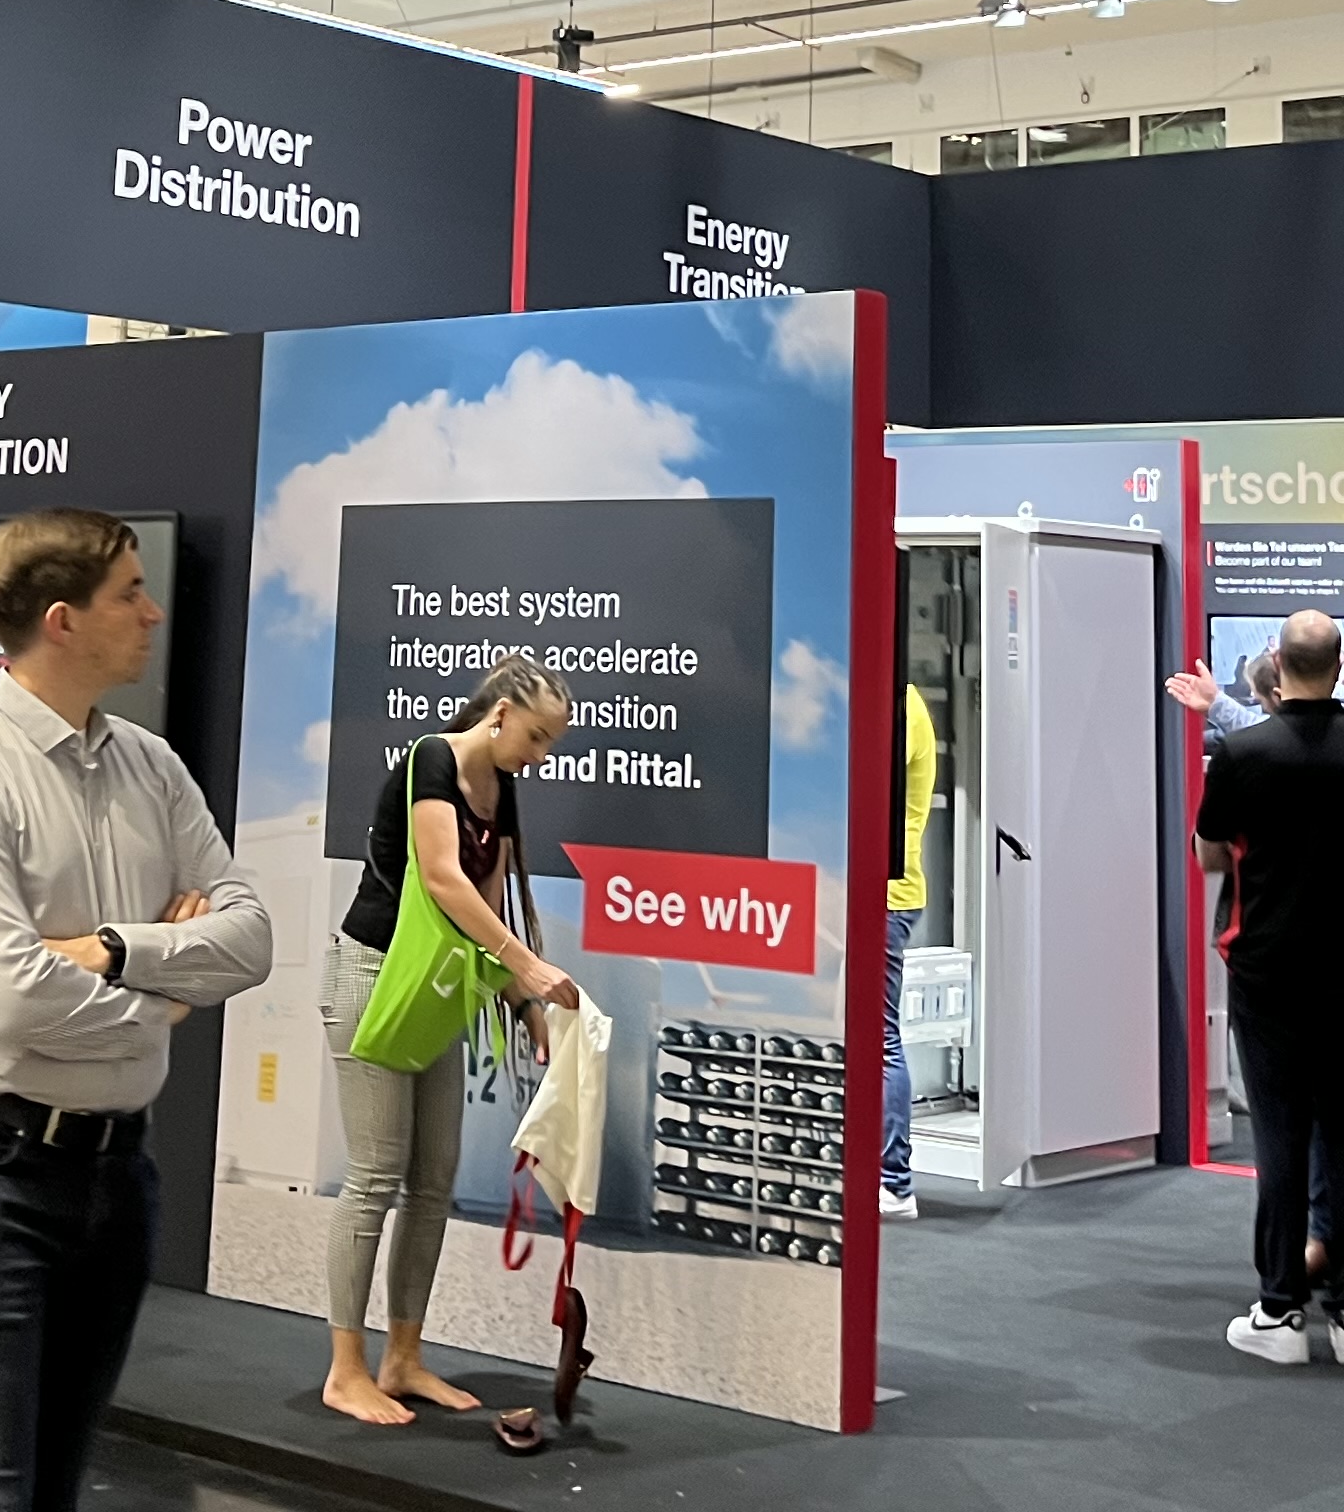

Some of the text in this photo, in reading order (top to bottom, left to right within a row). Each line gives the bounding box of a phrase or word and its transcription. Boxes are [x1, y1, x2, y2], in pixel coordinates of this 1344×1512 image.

[178, 97, 313, 167] Power
[114, 148, 361, 238] Distribution
[686, 204, 790, 270] Energy
[392, 584, 621, 627] The best system
[544, 639, 699, 676] accelerate
[387, 688, 430, 721] the
[567, 694, 678, 731] ansition
[539, 749, 598, 783] and
[606, 750, 702, 789] Rittal.
[605, 875, 792, 948] See why
